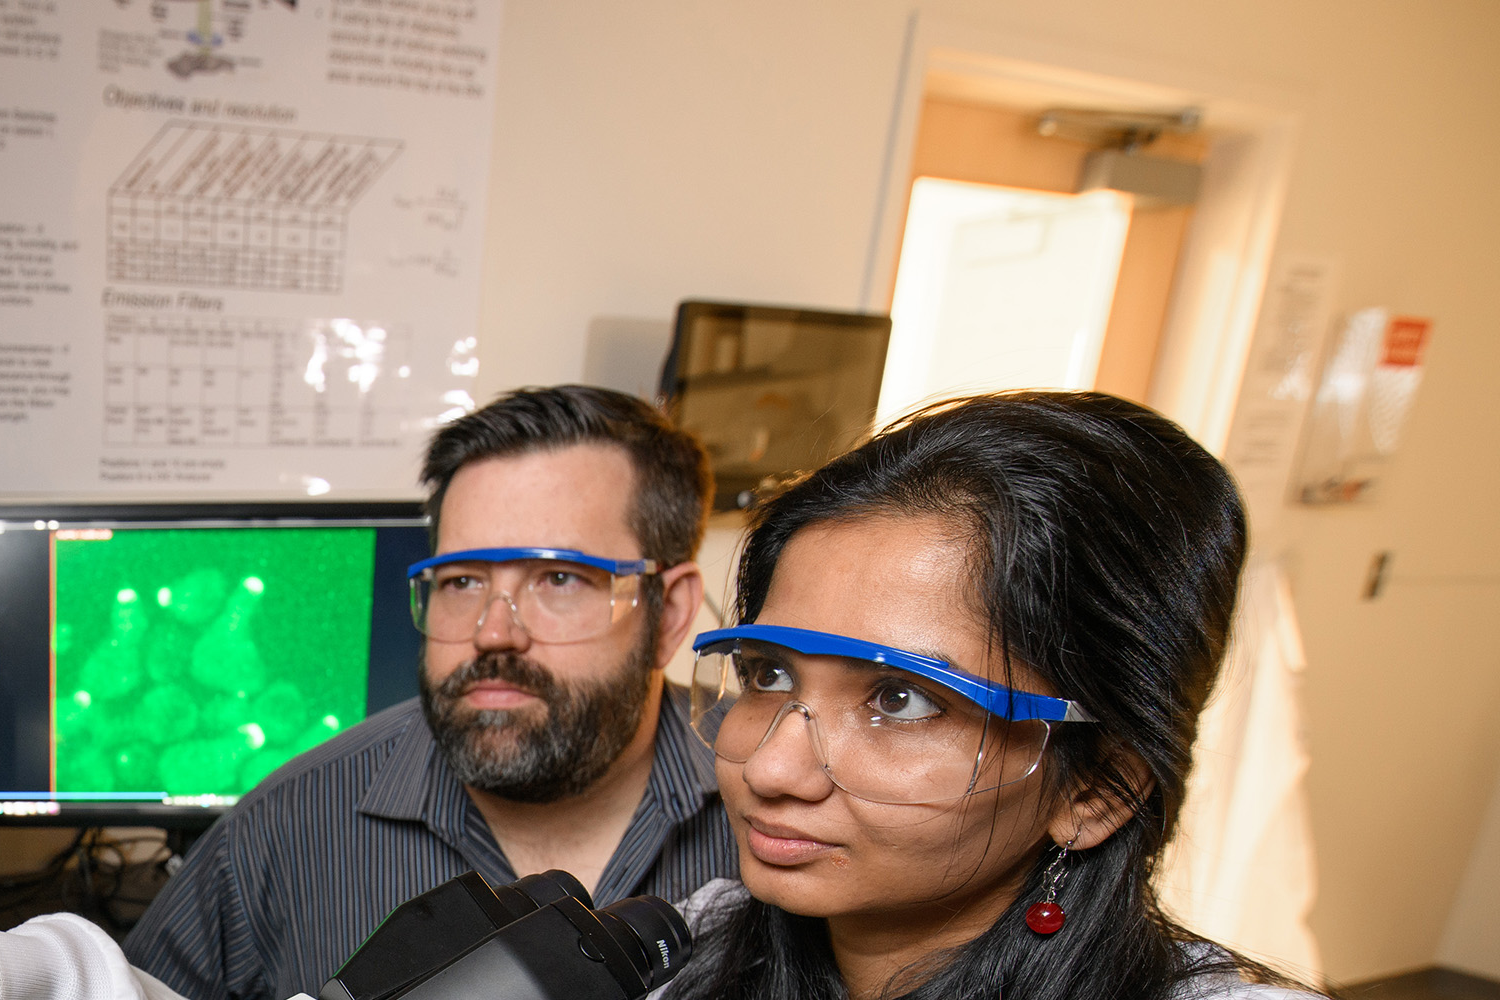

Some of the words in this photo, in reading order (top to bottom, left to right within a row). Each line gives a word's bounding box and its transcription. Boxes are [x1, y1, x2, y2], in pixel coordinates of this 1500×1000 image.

[102, 83, 186, 113] Objectives
[188, 97, 221, 116] and
[223, 102, 299, 121] resolution
[101, 285, 171, 309] Emission
[176, 290, 224, 312] Filters
[656, 939, 670, 969] Nikon
